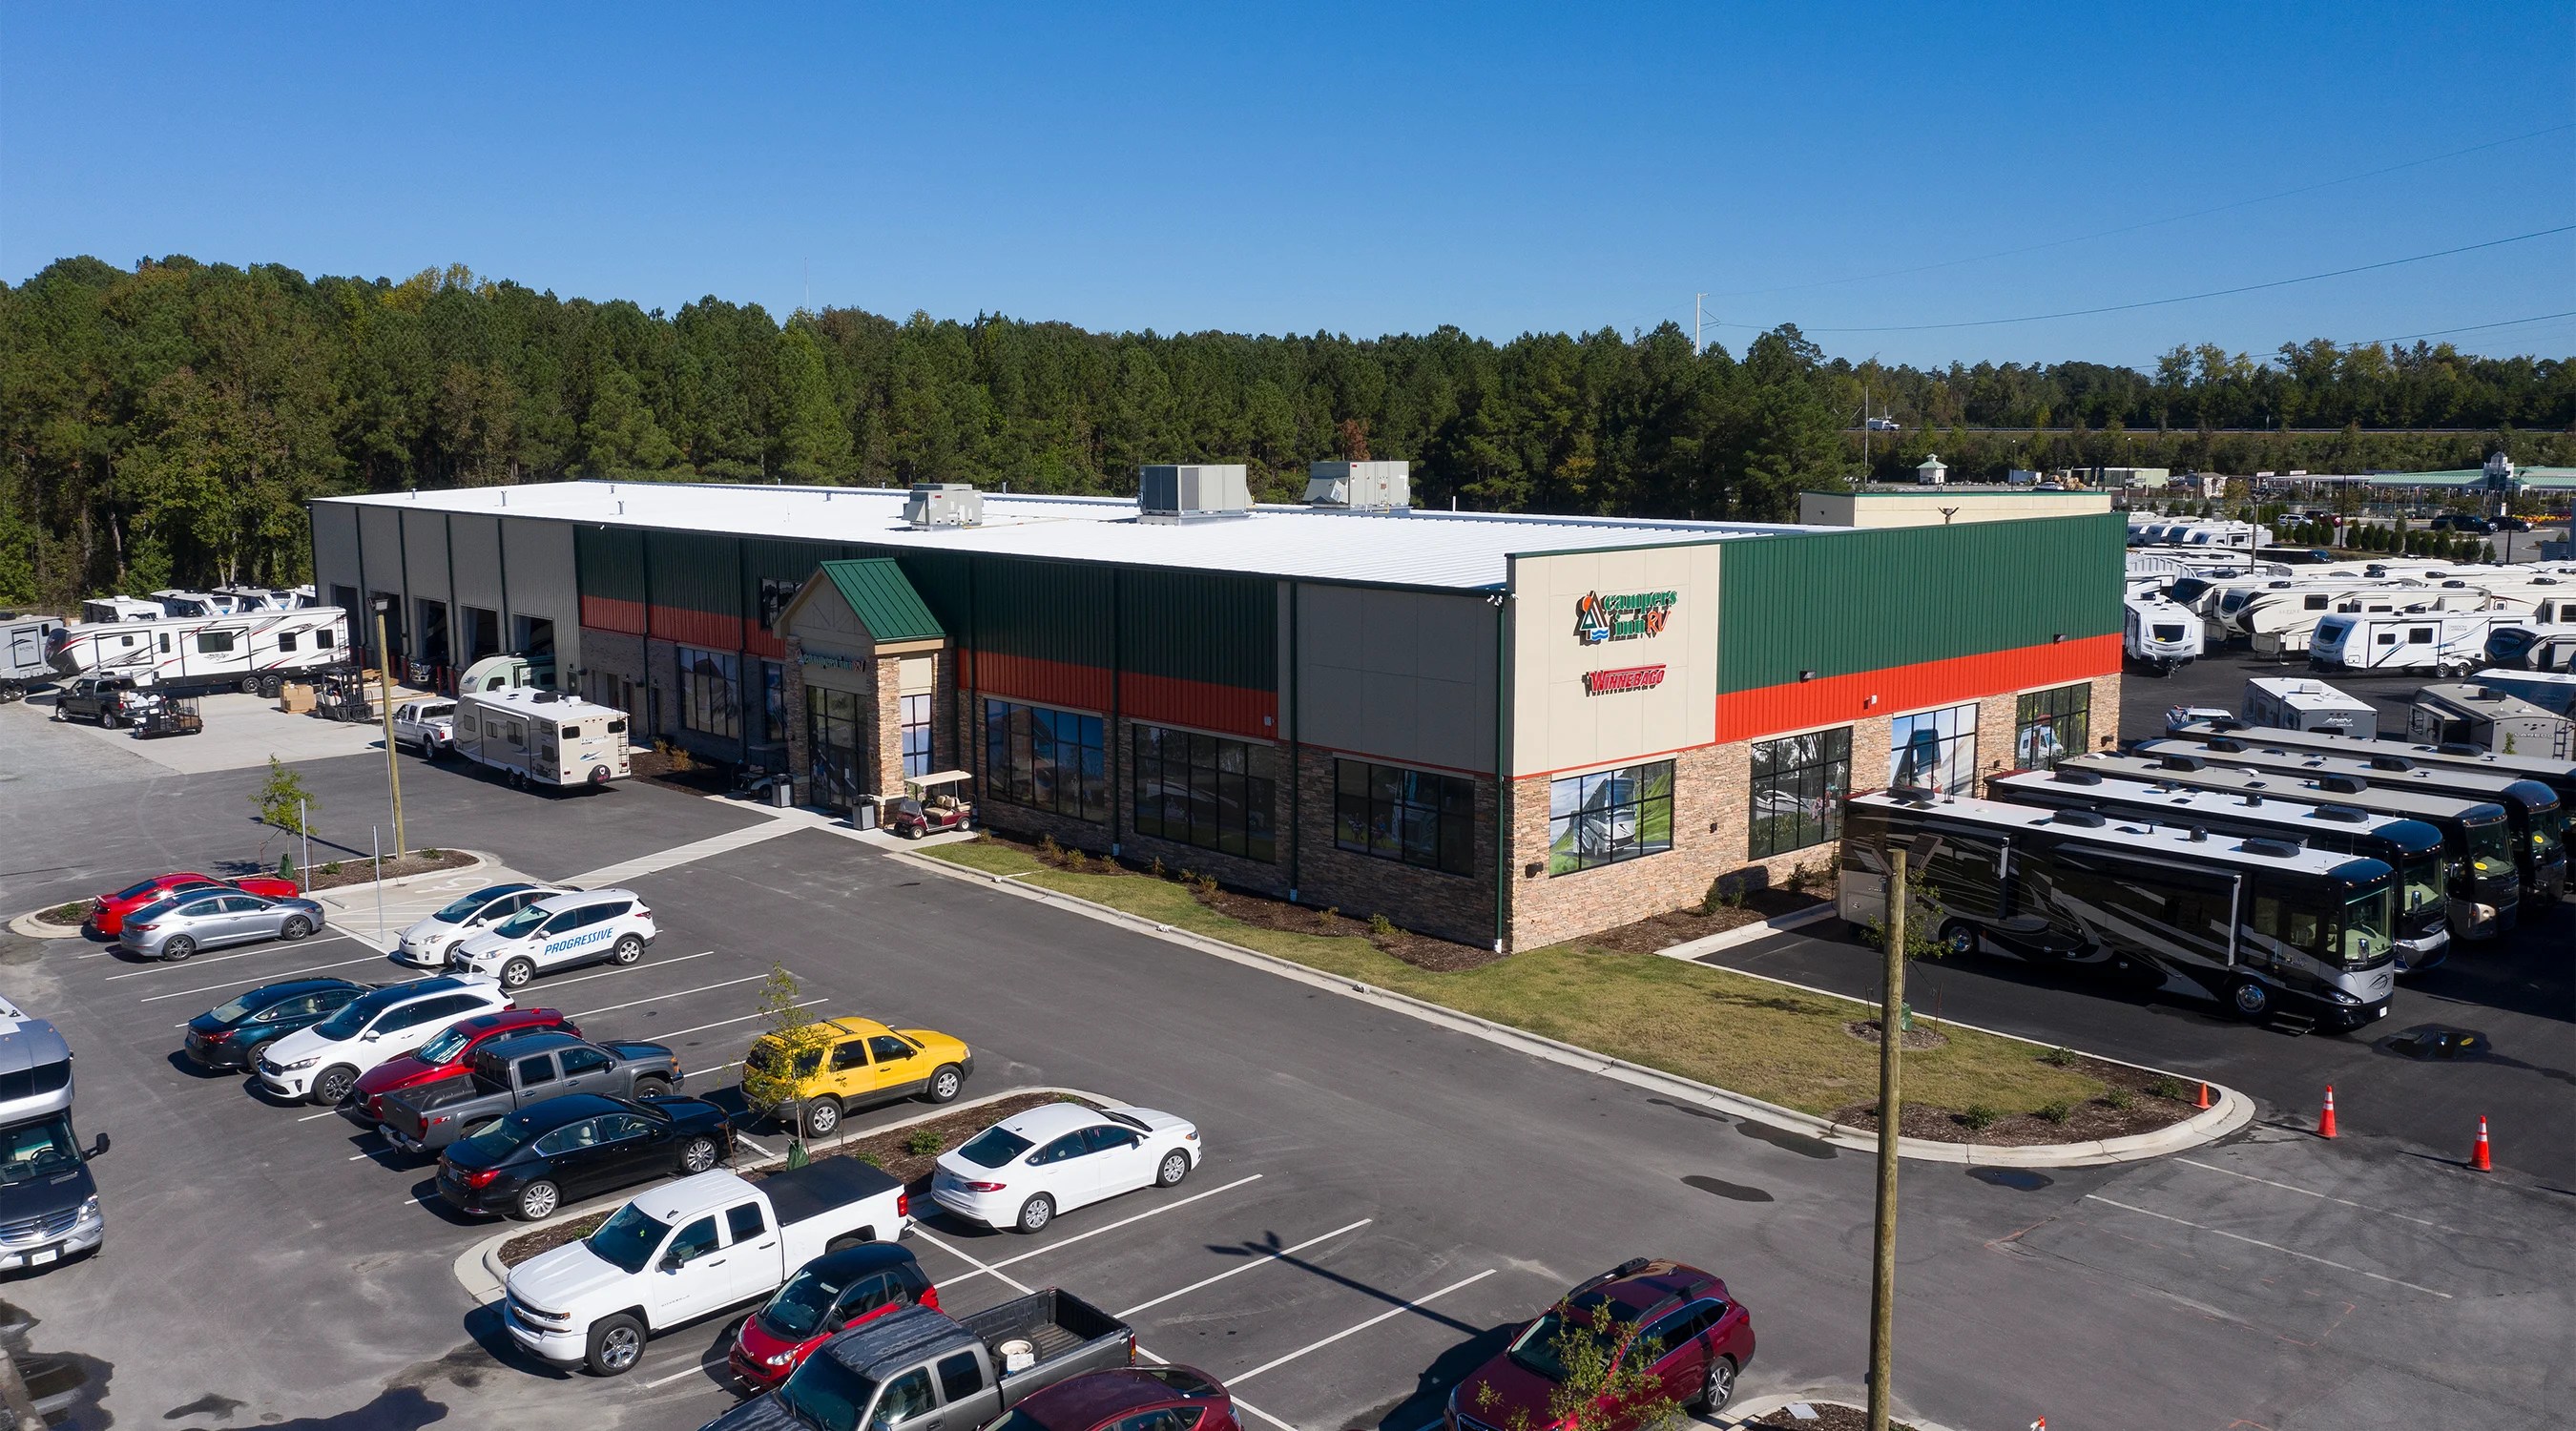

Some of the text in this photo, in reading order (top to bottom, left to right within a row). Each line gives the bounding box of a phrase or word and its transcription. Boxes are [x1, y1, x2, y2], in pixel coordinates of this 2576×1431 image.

[1604, 591, 1677, 613] campers
[1614, 611, 1672, 635] inn RV
[1589, 664, 1667, 692] WINNEBAGO
[544, 927, 613, 956] PROGRESSIVE
